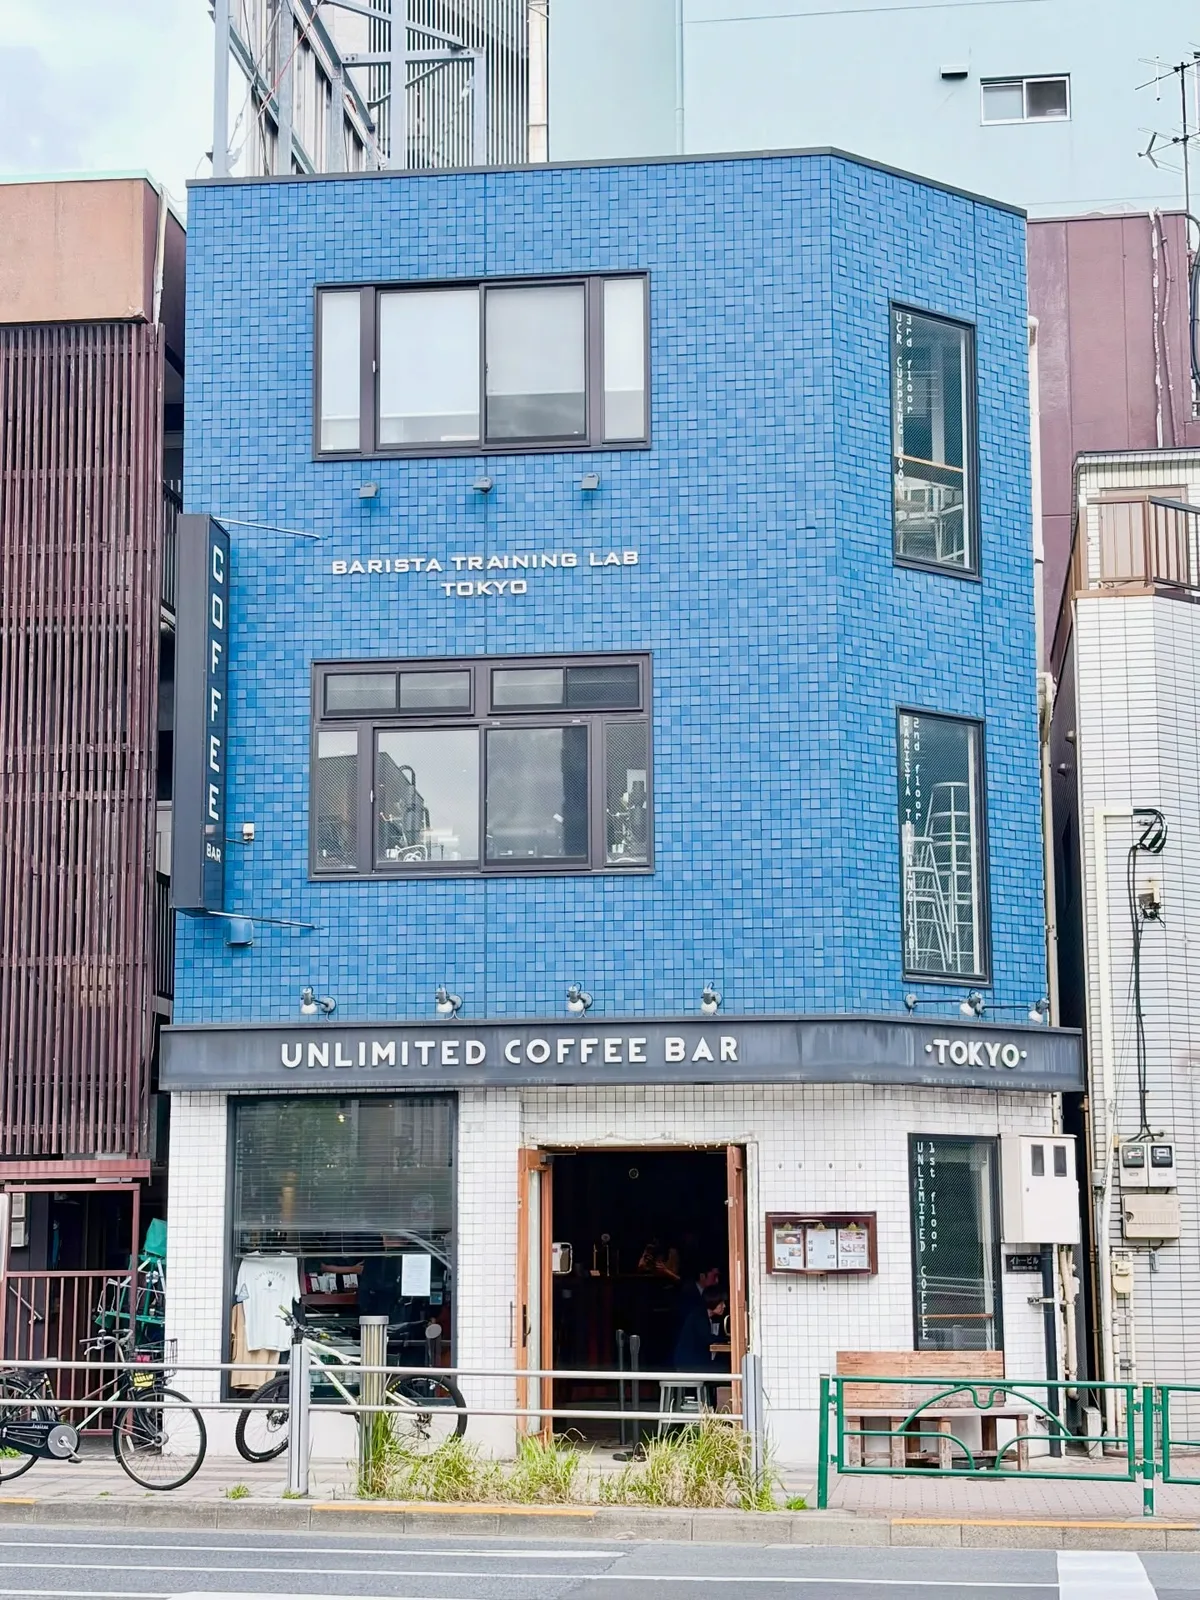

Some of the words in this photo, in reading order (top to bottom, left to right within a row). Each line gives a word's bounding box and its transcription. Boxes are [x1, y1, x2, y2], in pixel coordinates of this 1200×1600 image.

[896, 356, 904, 434] CUPPING
[332, 557, 443, 576] BARISTA
[451, 552, 578, 571] TRAINING
[589, 550, 639, 567] LAB
[440, 579, 528, 597] TOKYO
[209, 544, 224, 821] COFFEE
[903, 716, 911, 796] BARISTA
[914, 763, 922, 821] floor
[206, 842, 222, 863] BAR
[280, 1040, 487, 1068] UNLIMITED
[504, 1037, 648, 1065] COFFEE
[664, 1036, 739, 1063] BAR
[916, 1141, 926, 1252] UNLIMITED
[930, 1191, 938, 1251] floor
[920, 1265, 929, 1340] COFFEE
